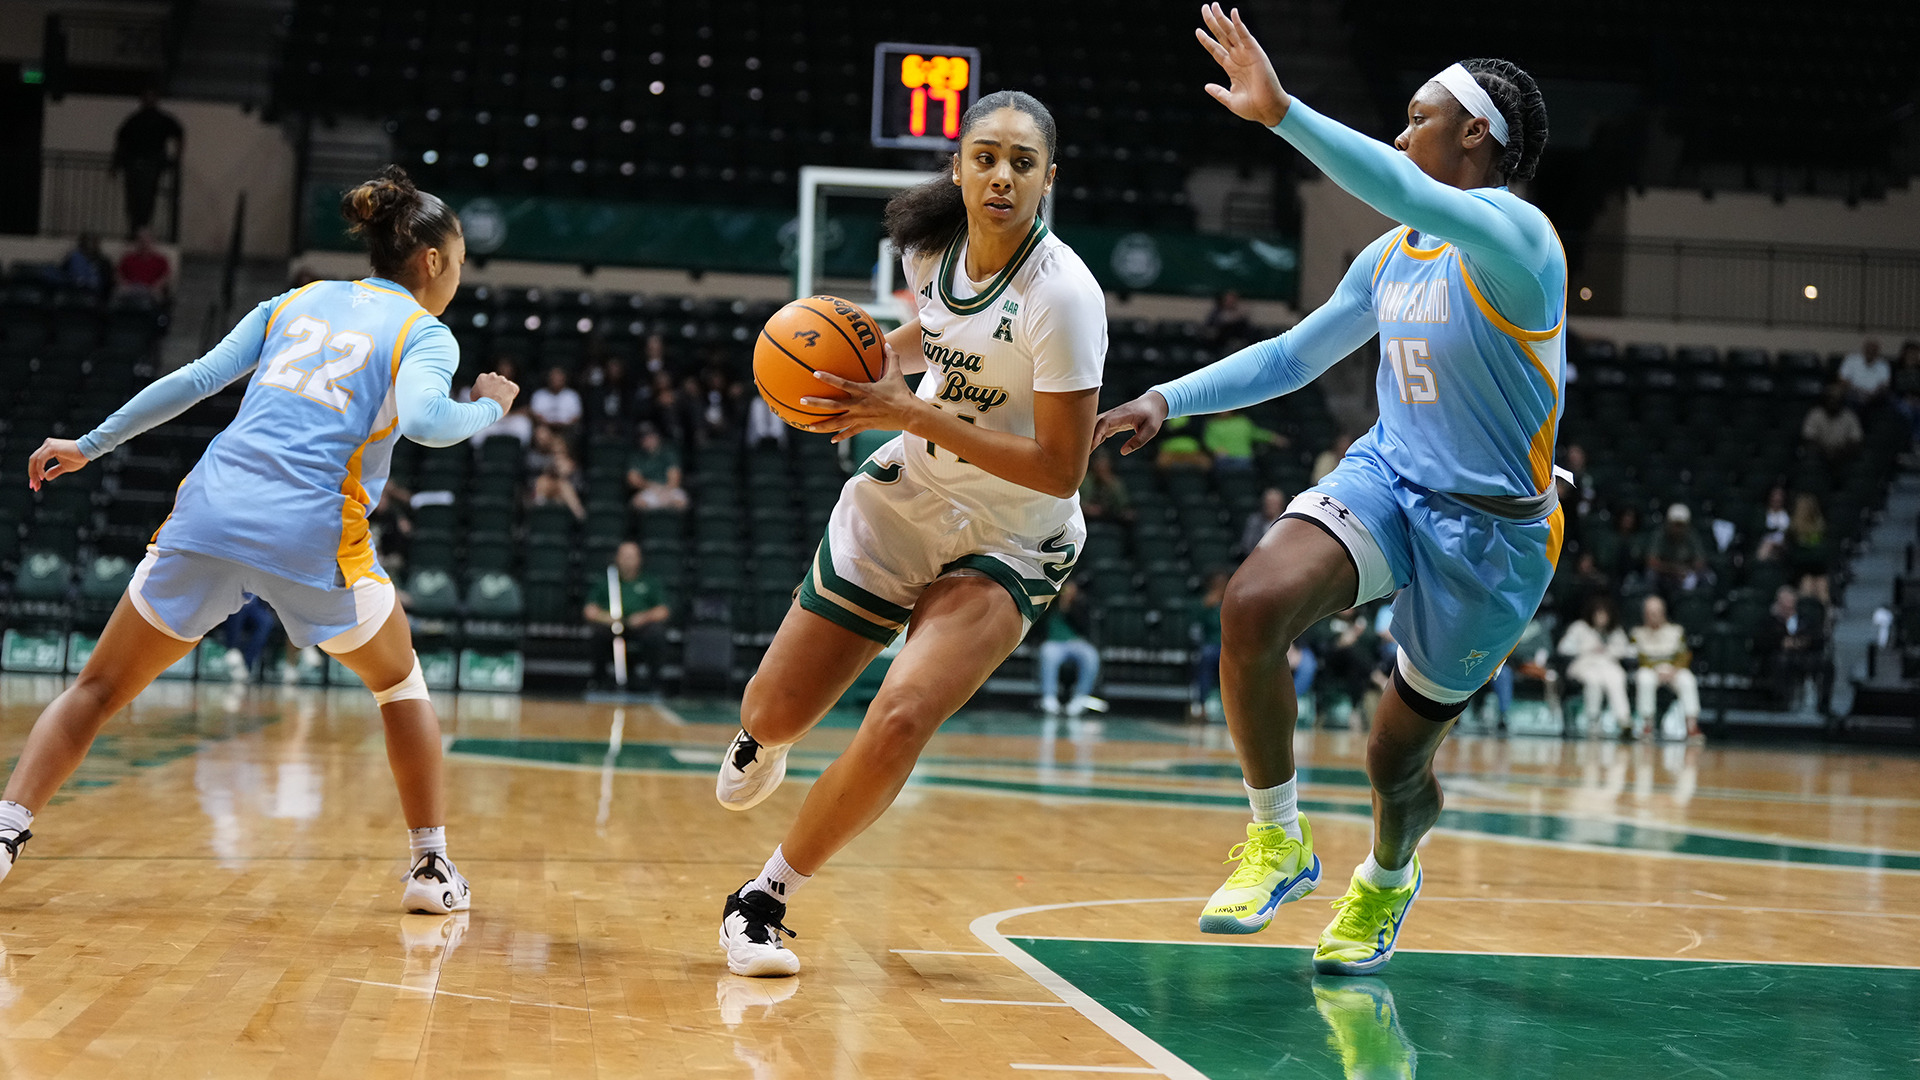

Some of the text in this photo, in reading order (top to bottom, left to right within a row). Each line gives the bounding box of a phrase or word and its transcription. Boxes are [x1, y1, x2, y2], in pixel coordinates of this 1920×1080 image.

[909, 87, 960, 139] 17
[1002, 299, 1019, 316] AAR
[1402, 278, 1450, 323] ISLAND
[258, 314, 375, 414] 22
[920, 323, 984, 375] Tampa
[1387, 337, 1440, 404] 15
[937, 370, 1009, 414] Bay
